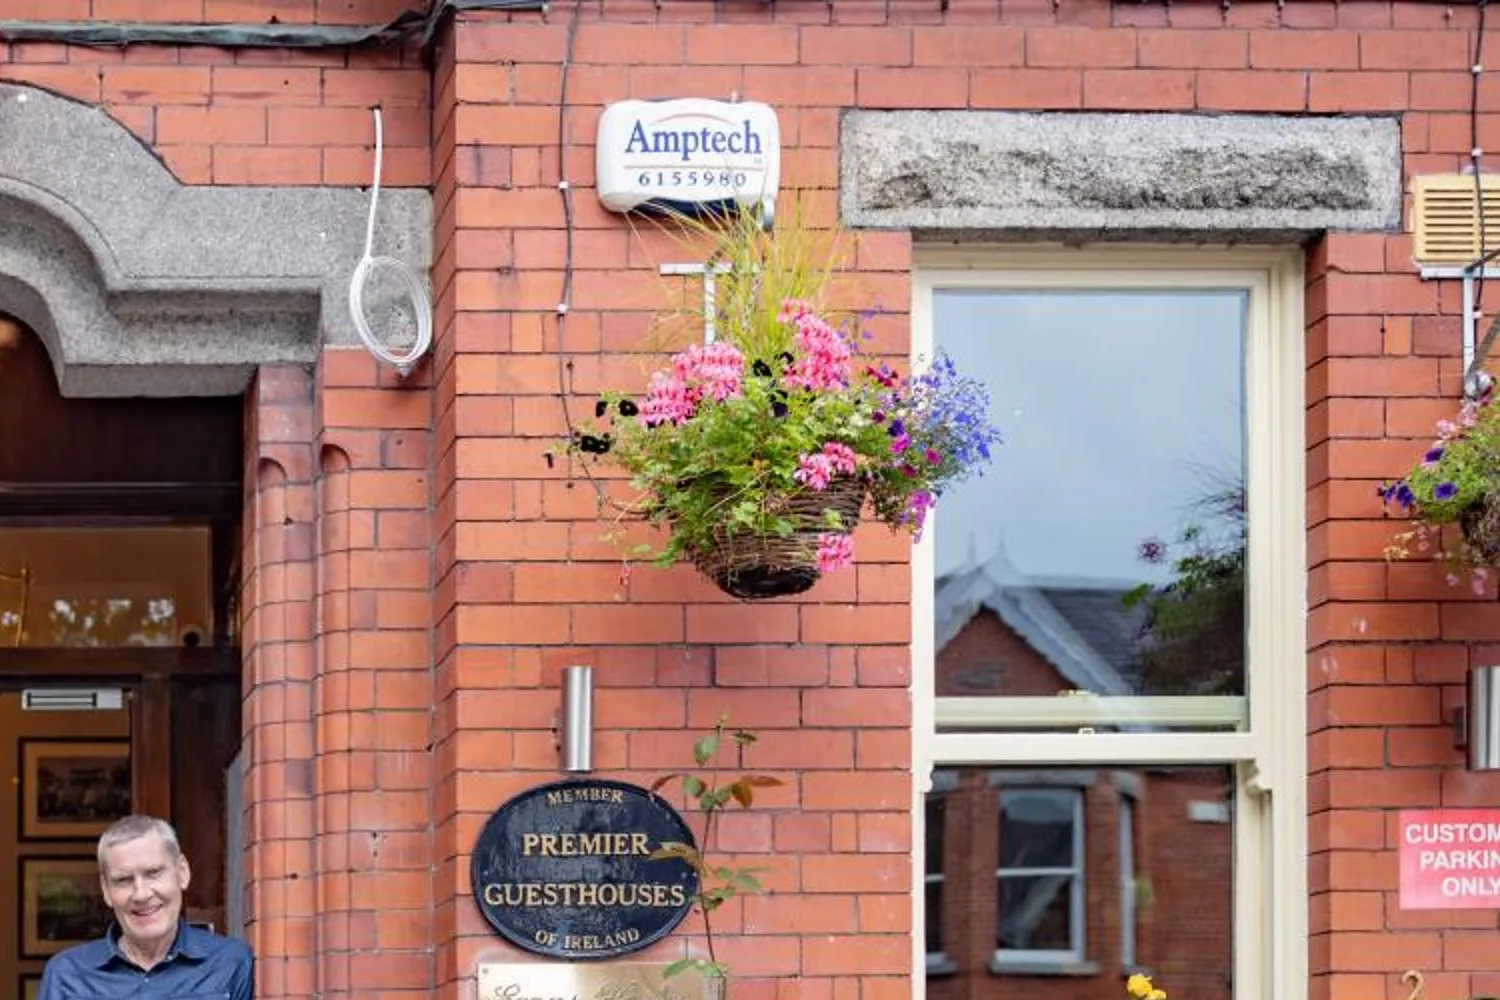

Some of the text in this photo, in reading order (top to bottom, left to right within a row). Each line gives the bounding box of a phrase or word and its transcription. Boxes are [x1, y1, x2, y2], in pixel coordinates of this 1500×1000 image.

[624, 119, 762, 161] Amptech
[638, 171, 747, 187] 6155980
[547, 787, 624, 805] MEMBER
[522, 833, 650, 856] PREMIER
[484, 883, 685, 907] GUESTHOUSES
[1443, 876, 1500, 896] ONLY
[535, 927, 640, 949] OF IRELAND
